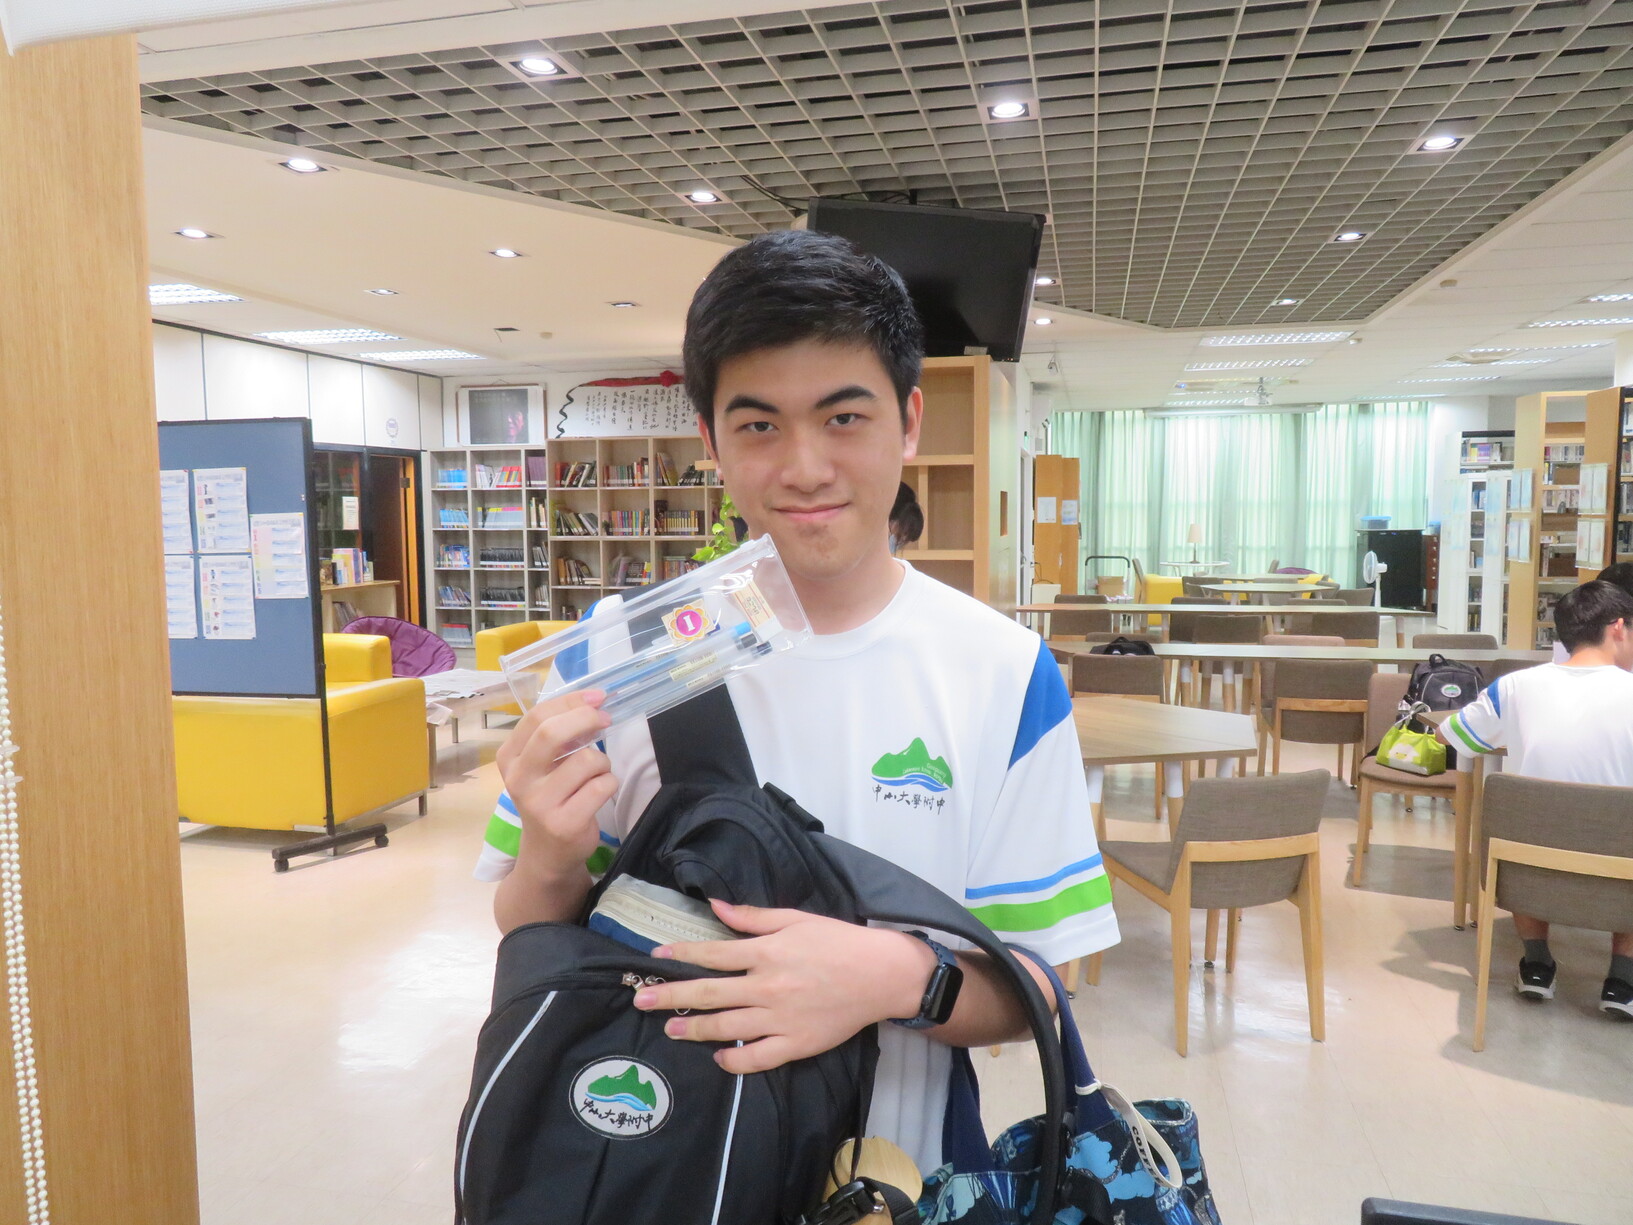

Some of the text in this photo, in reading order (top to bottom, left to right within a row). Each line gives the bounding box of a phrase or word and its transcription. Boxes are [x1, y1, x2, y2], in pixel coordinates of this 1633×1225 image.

[872, 784, 945, 815] 中山大學附中
[580, 1098, 653, 1131] 中山大學附中
